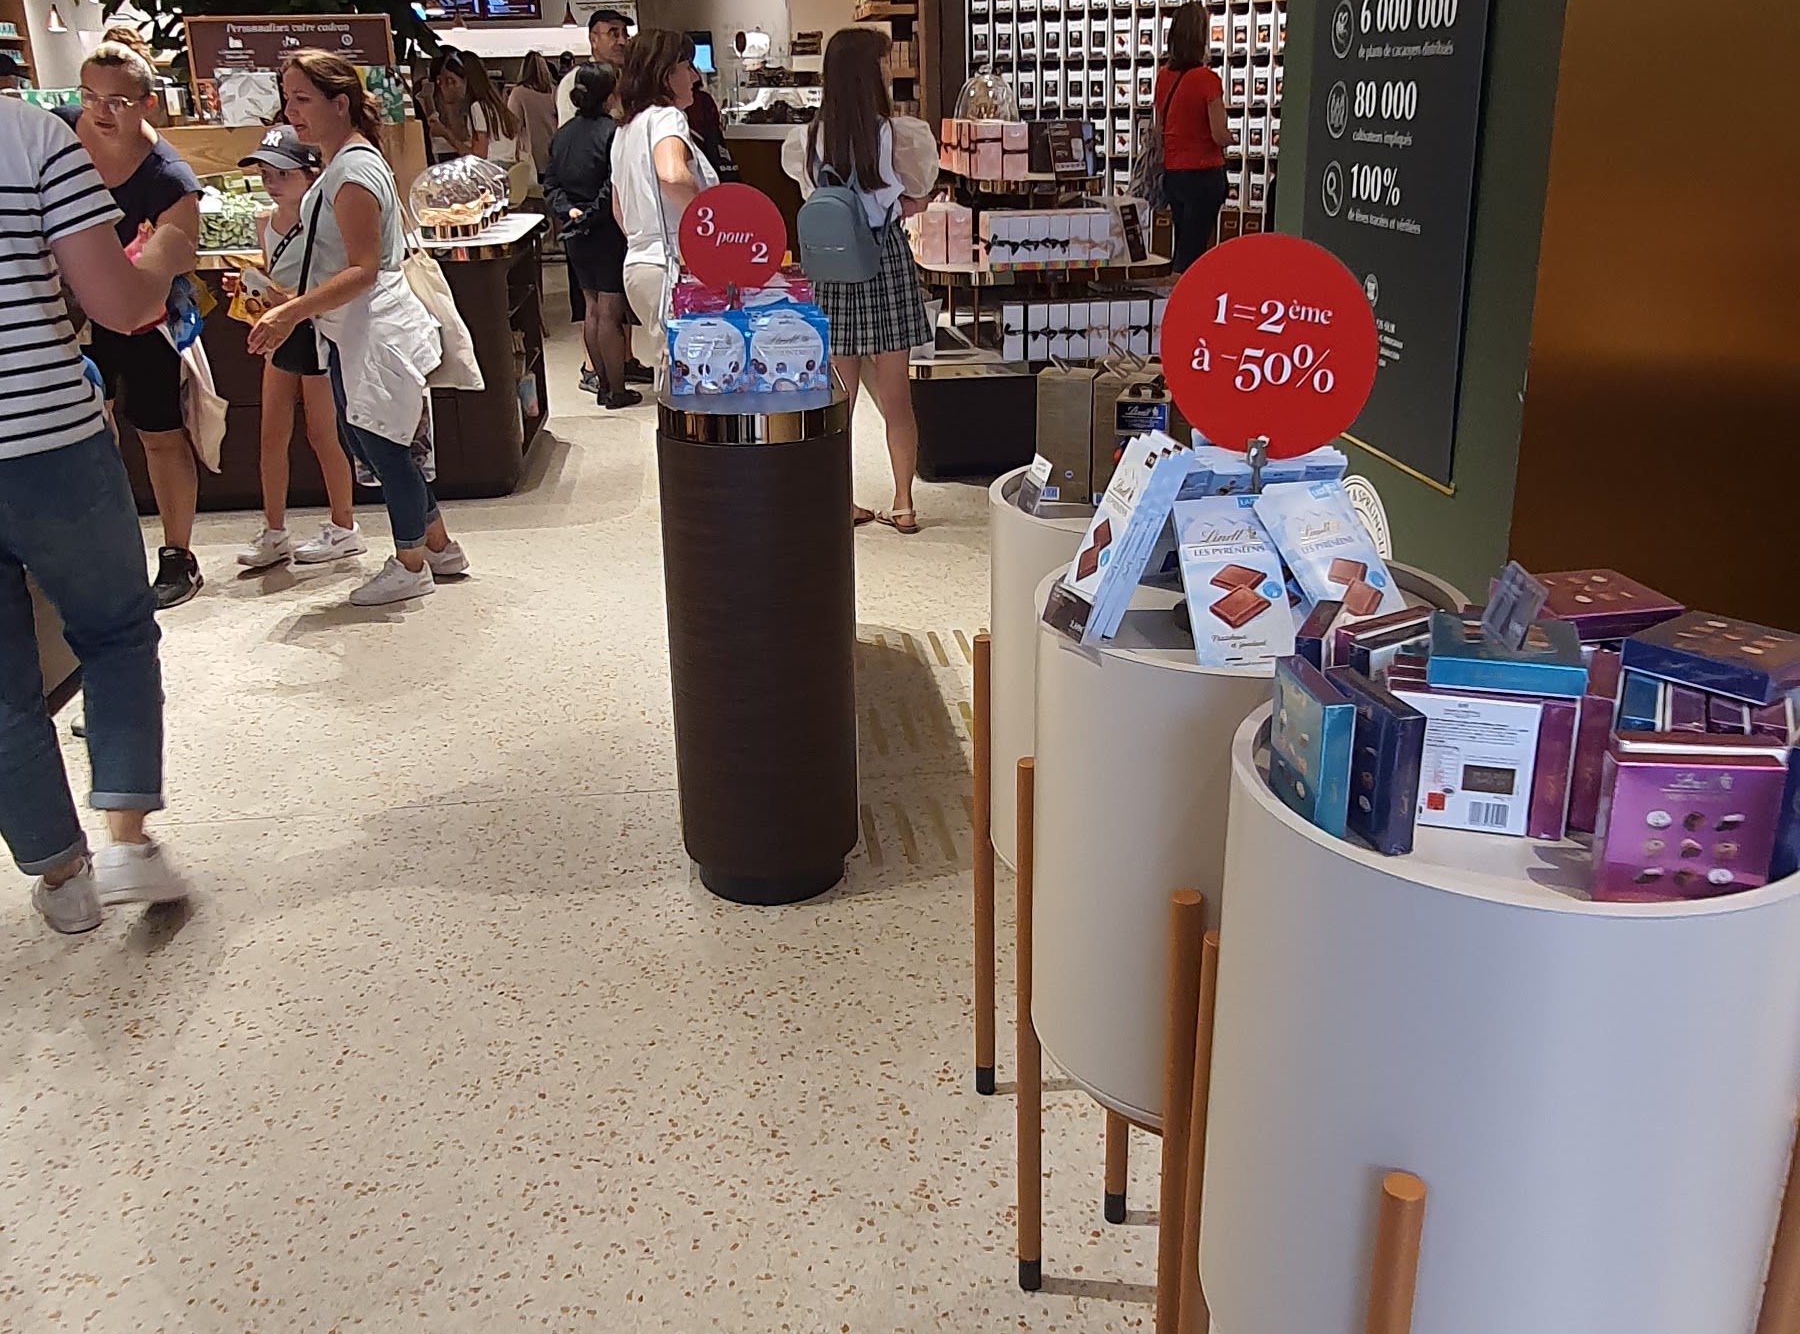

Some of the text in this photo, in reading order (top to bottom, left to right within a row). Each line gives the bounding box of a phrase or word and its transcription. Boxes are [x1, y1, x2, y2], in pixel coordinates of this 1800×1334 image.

[1354, 80, 1418, 121] 80 000
[1350, 162, 1401, 206] 100%
[696, 206, 715, 237] 3
[715, 231, 754, 247] pour
[750, 242, 769, 263] 2
[1191, 338, 1211, 373] à
[1200, 529, 1244, 543] Lindt
[1194, 547, 1211, 557] LES
